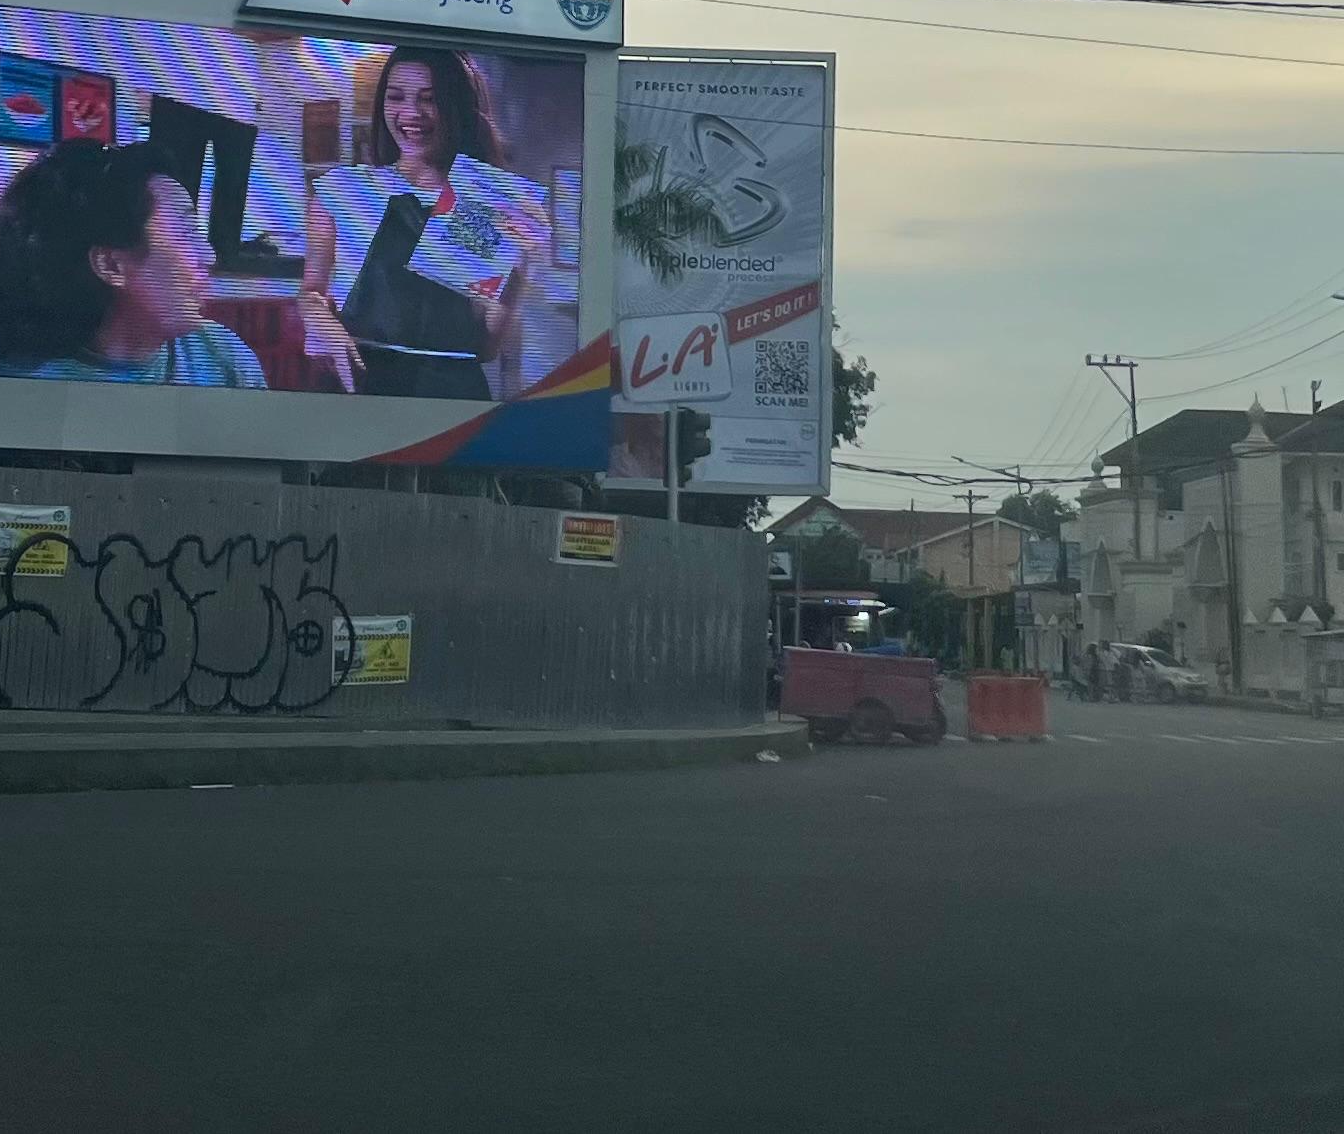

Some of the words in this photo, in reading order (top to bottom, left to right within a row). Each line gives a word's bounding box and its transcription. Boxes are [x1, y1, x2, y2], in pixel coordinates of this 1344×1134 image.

[635, 80, 693, 93] PERFECT
[699, 84, 757, 95] SMOOTH
[763, 86, 805, 97] TASTE
[736, 309, 771, 332] LET'S
[775, 302, 791, 318] DO
[674, 381, 711, 392] LIGHTS
[755, 395, 787, 406] SCAN
